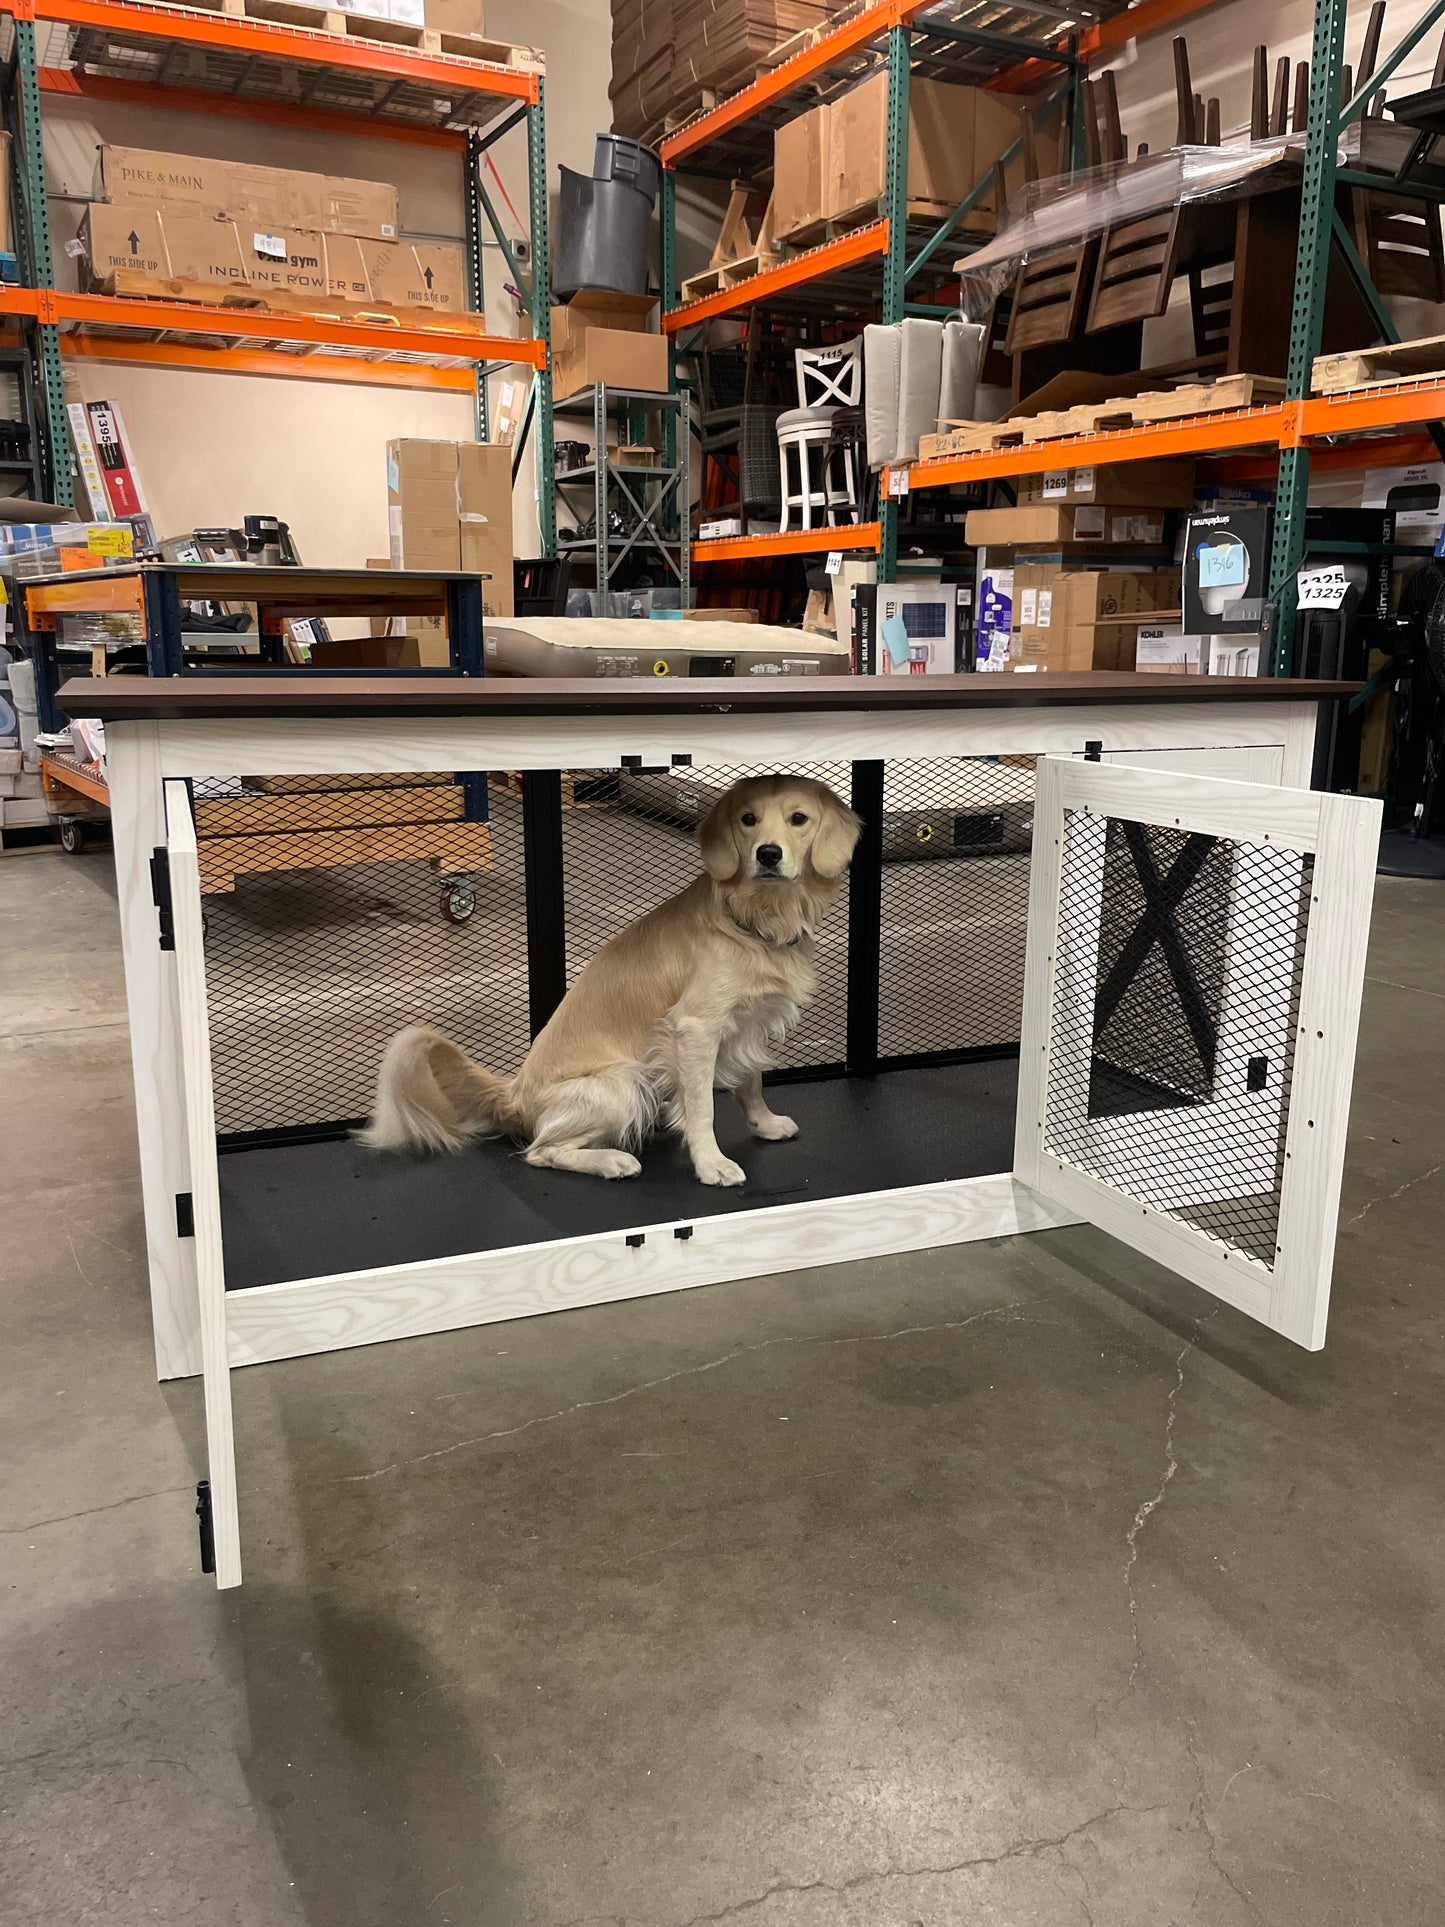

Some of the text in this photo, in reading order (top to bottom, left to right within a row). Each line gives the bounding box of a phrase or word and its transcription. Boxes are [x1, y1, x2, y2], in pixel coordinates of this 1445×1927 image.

[122, 168, 204, 190] PIKE & MAIN
[108, 255, 158, 271] THIS SIDE UP
[291, 255, 318, 269] gym
[209, 265, 281, 283] INCLINE
[287, 274, 347, 291] ROWER
[407, 291, 422, 301] THIS
[440, 294, 450, 304] UP
[820, 349, 843, 360] 1115
[97, 412, 112, 443] 1395
[1045, 478, 1067, 490] 1269
[1192, 515, 1230, 526] simplehuman
[828, 558, 840, 567] 1141
[1304, 588, 1345, 599] 1325
[886, 602, 894, 621] ATTS
[1140, 630, 1164, 638] KOHLER
